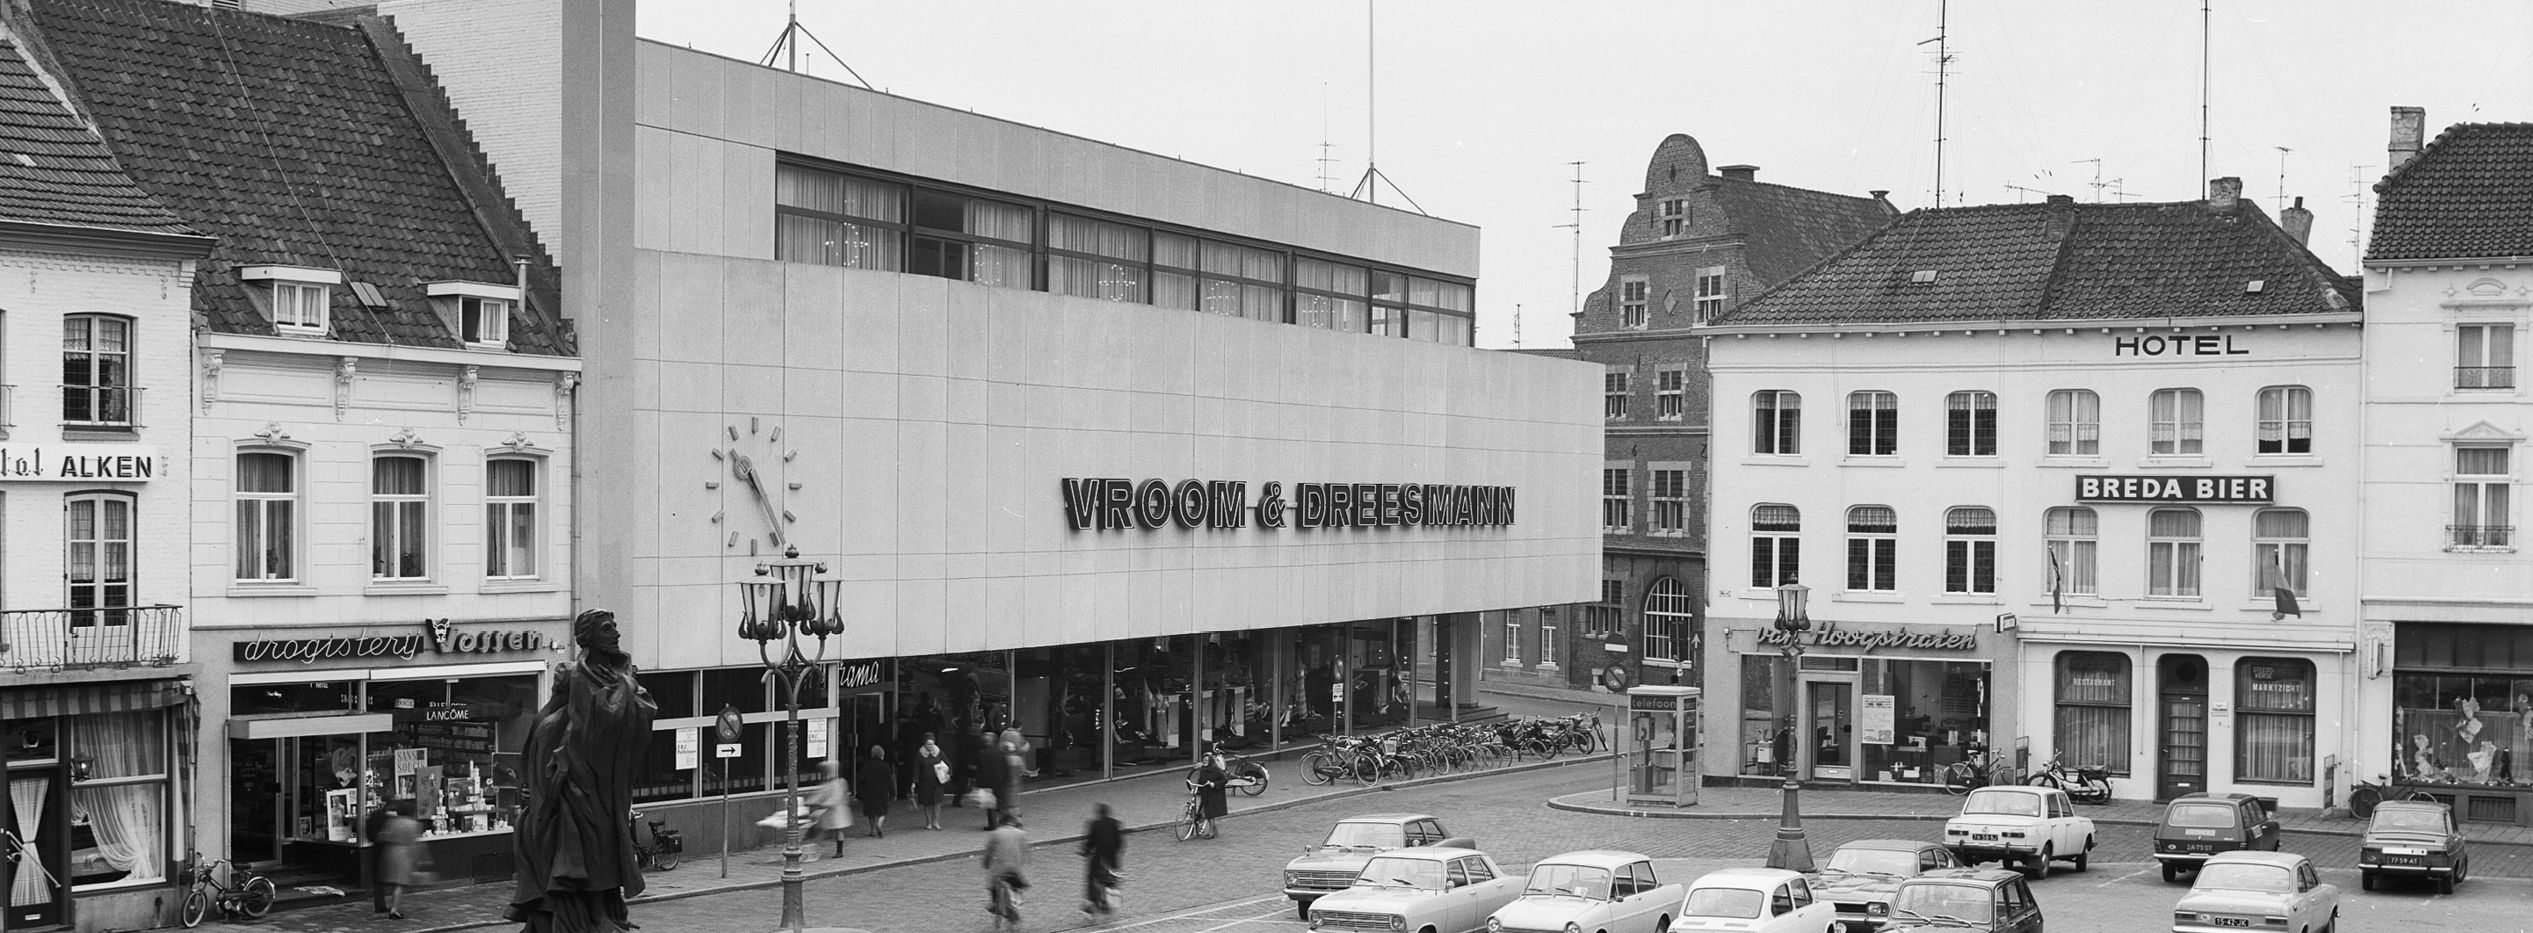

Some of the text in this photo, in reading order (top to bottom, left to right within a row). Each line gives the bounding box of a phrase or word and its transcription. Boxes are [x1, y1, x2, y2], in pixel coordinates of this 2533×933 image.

[2115, 335, 2250, 357] HOTEL
[60, 455, 152, 478] ALKEN
[2082, 478, 2268, 499] BREDA BIER
[1062, 478, 1517, 529] VROOM & DREESMANN
[244, 617, 544, 664] drogisterij Vossen
[1809, 620, 1978, 653] Hoogstraten
[2073, 678, 2115, 686] RESTAURANT
[2252, 683, 2300, 692] MARKTZICHT
[1632, 698, 1676, 708] telefoon
[426, 708, 469, 720] LANCÔME
[397, 751, 417, 761] SANS
